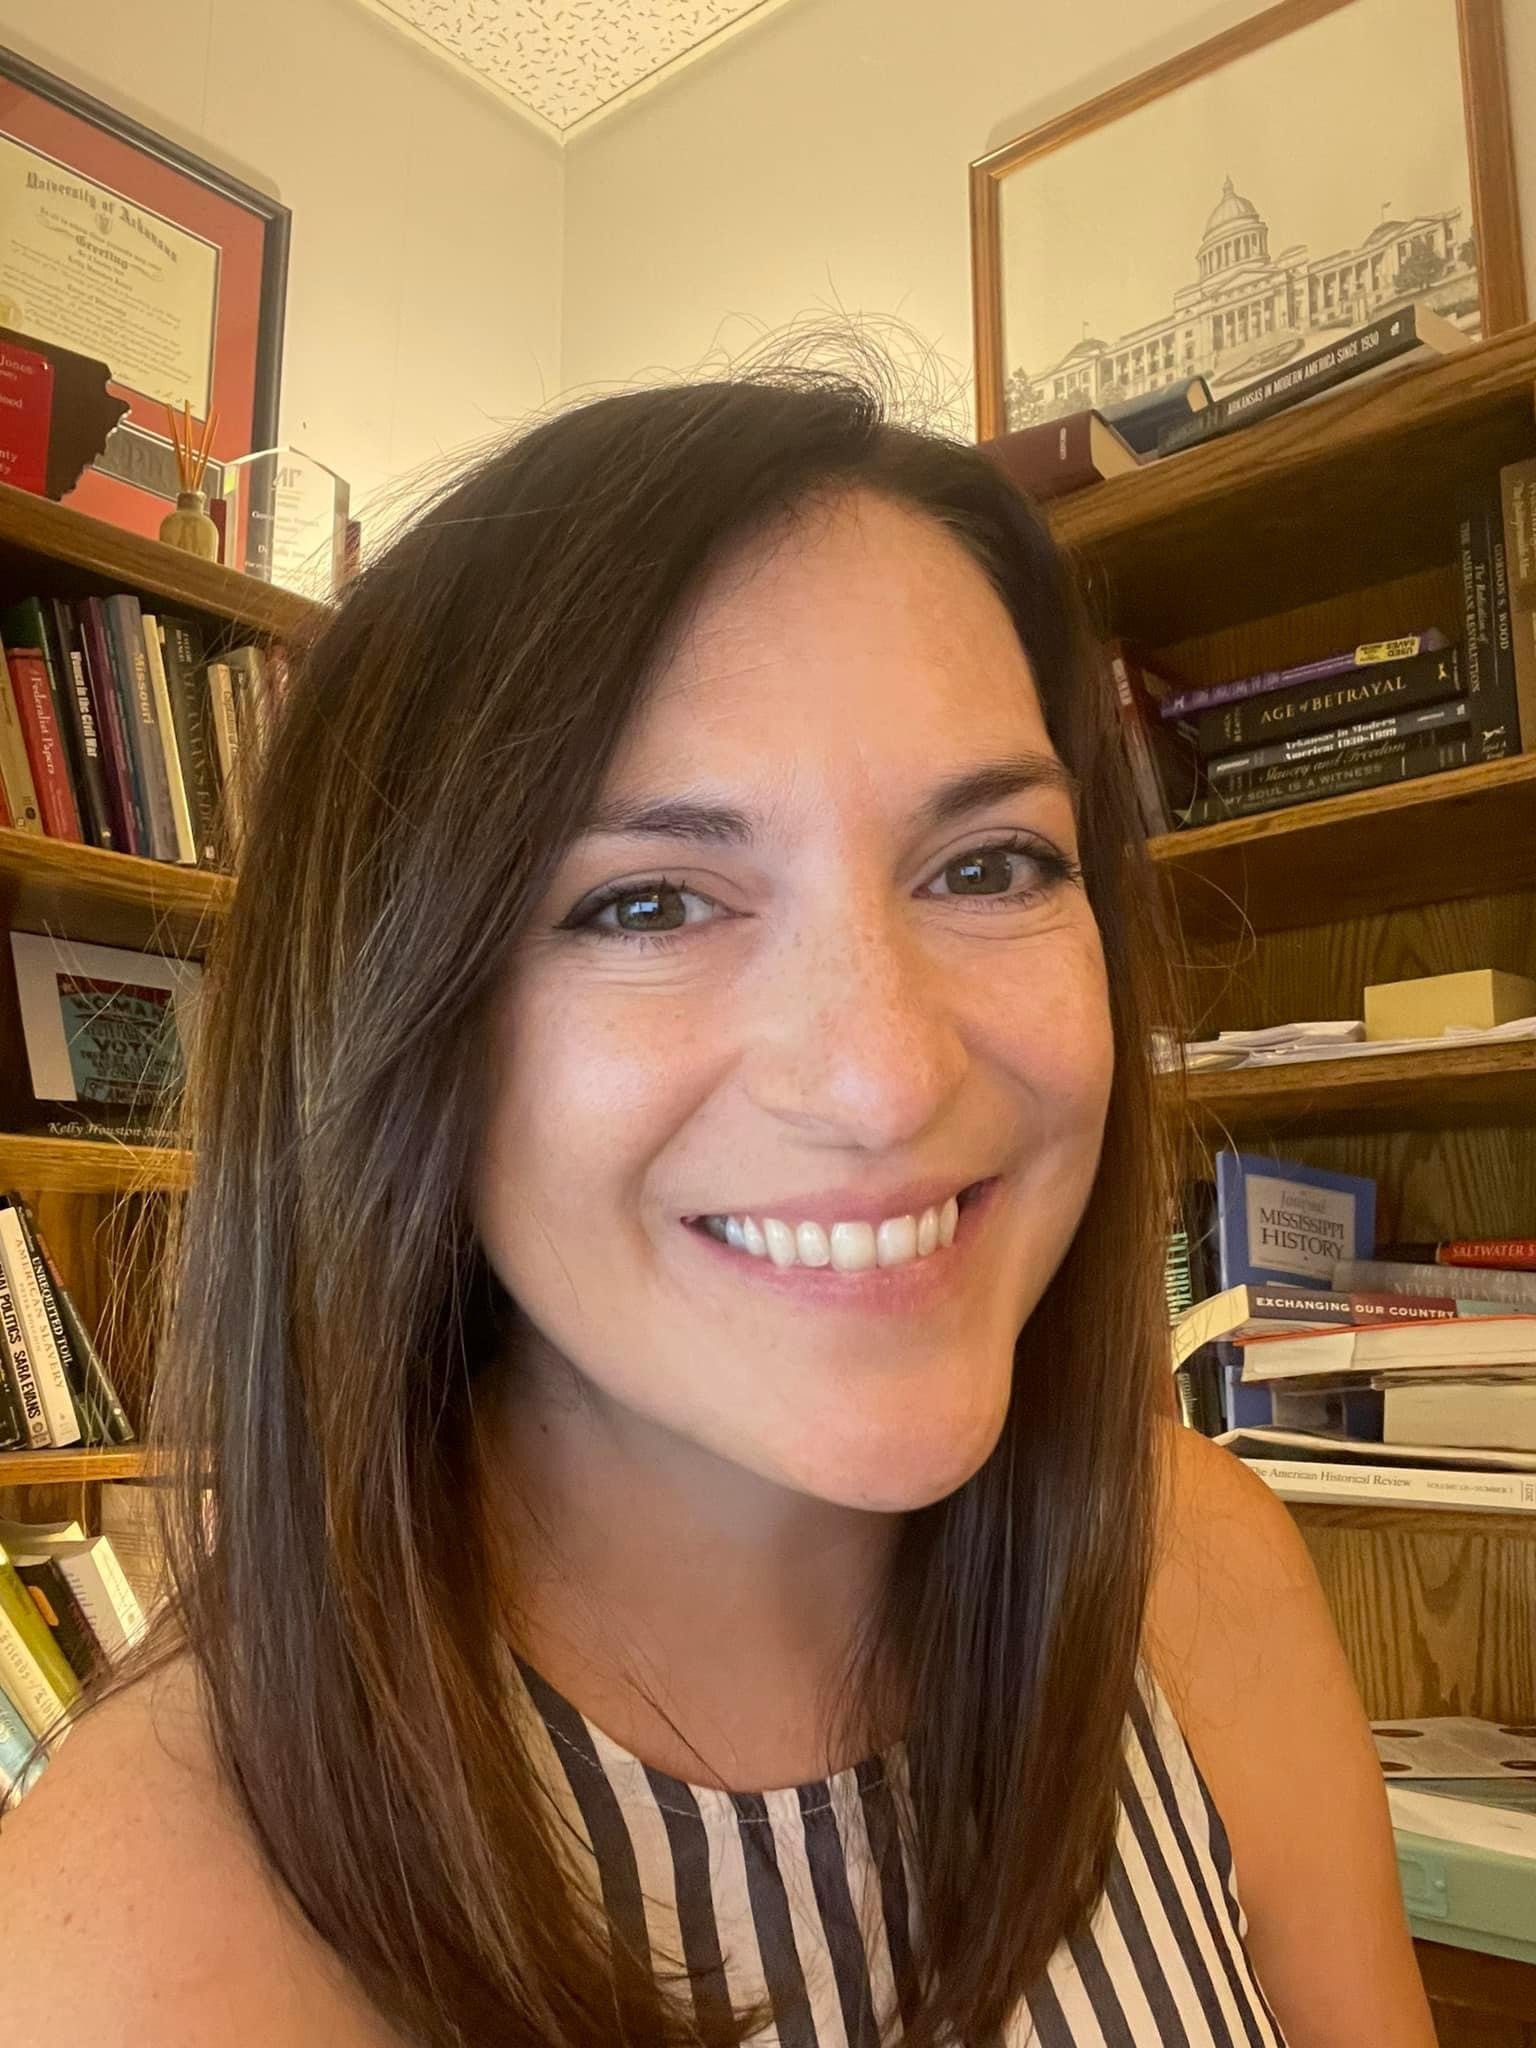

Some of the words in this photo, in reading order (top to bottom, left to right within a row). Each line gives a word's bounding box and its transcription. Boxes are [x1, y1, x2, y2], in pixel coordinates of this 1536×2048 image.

[1225, 386, 1265, 416] ARKANSAS
[1263, 382, 1274, 398] IN
[1272, 368, 1304, 394] MODERN
[1302, 352, 1336, 379] AMERICA
[1334, 342, 1359, 364] SINCE
[1359, 331, 1381, 352] 1930
[1498, 612, 1509, 649] WOOD
[1388, 647, 1413, 657] USED
[78, 696, 90, 713] the
[133, 652, 154, 725] Missouri
[1261, 703, 1295, 724] AGE
[1312, 676, 1407, 712] BETRAYAL
[32, 676, 49, 734] Federalist
[41, 737, 54, 775] Papers
[81, 714, 96, 738] Civil
[85, 738, 97, 758] War
[48, 1122, 84, 1135] Kelly
[1260, 1207, 1344, 1241] MISSISSIPPI
[1262, 1227, 1344, 1261] HISTORY
[1453, 1243, 1524, 1257] SALTWATER
[0, 1293, 23, 1345] POLITICS
[15, 1237, 43, 1318] AMERICAN
[38, 1324, 65, 1390] SLAVERY
[31, 1256, 65, 1336] UNREQUITED
[56, 1335, 74, 1367] TOIL
[1256, 1296, 1350, 1313] EXCHANGING
[1354, 1304, 1385, 1315] OUR
[1389, 1307, 1455, 1320] COUNTRY
[13, 1350, 32, 1384] SARA
[20, 1382, 42, 1419] EVANS
[1269, 1467, 1319, 1482] American
[1320, 1469, 1370, 1486] Historical
[1373, 1474, 1412, 1488] Review
